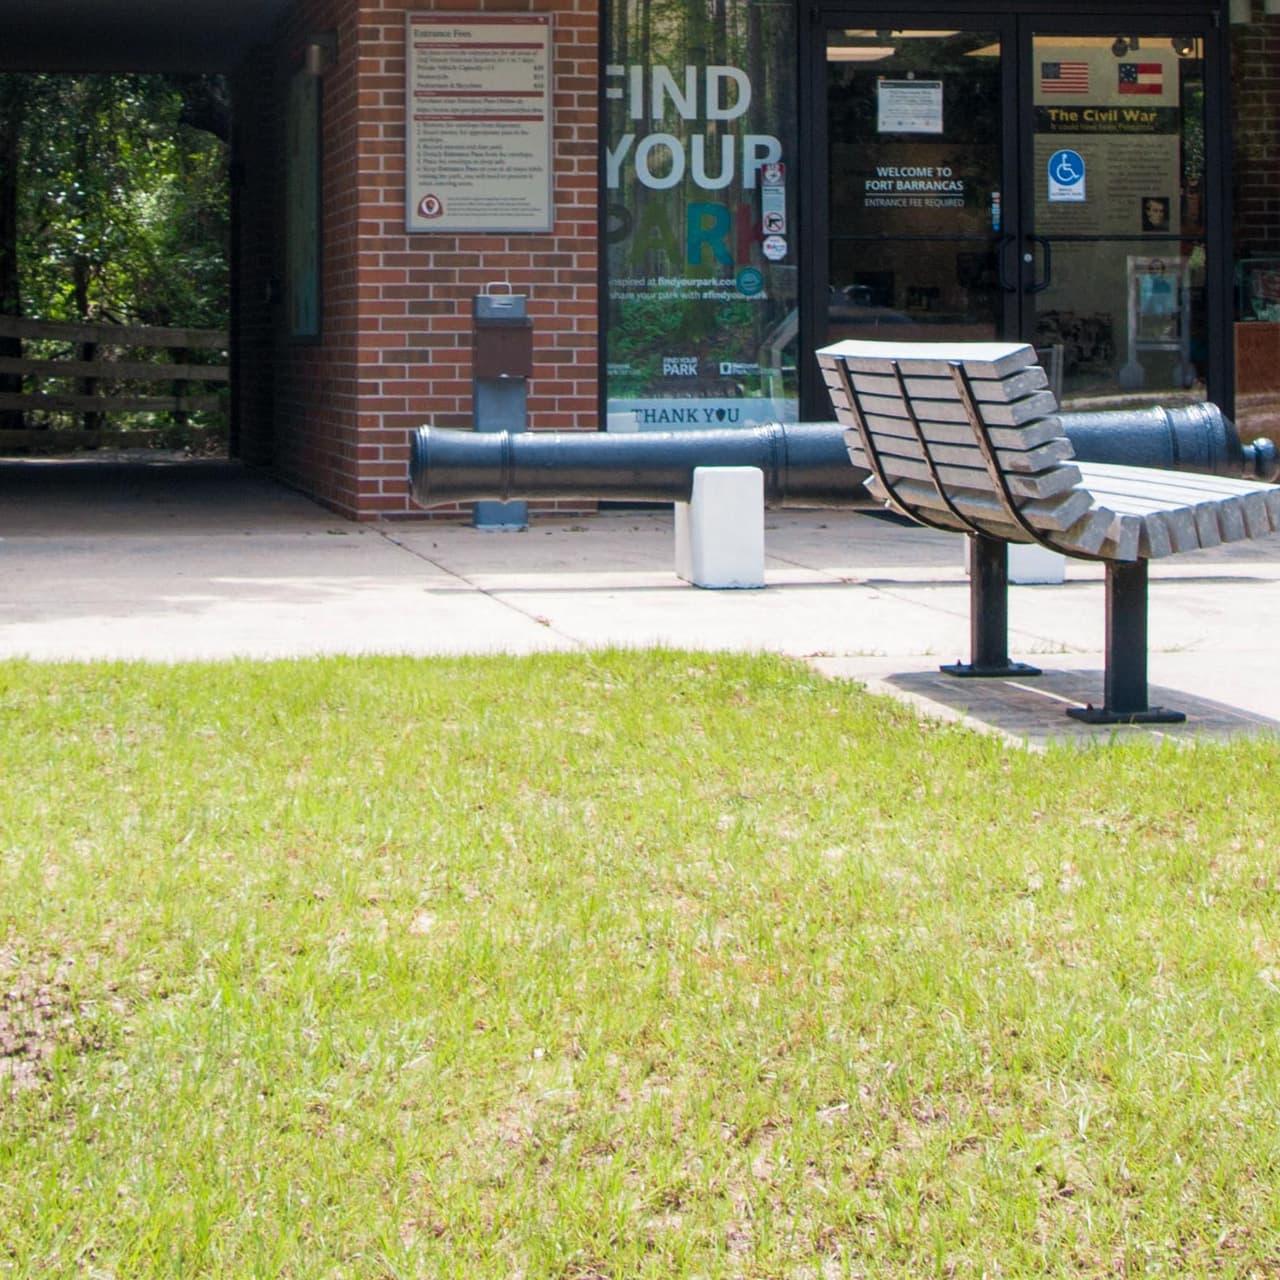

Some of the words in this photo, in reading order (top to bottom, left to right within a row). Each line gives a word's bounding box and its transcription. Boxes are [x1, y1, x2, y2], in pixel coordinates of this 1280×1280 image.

[414, 29, 451, 38] Entrance
[453, 29, 472, 38] Fees
[606, 65, 752, 120] FIND
[1048, 109, 1078, 121] The
[1083, 109, 1118, 121] Civil
[1124, 109, 1157, 122] War
[606, 133, 782, 190] YOUR
[877, 167, 933, 177] WELCOME
[936, 167, 952, 177] TO
[865, 181, 893, 190] FORT
[896, 181, 964, 191] BARRANCAS
[865, 198, 909, 207] ENTRANCE
[910, 198, 925, 207] FEE
[926, 198, 965, 208] REQUIRED
[647, 277, 656, 287] at
[636, 293, 657, 302] your
[658, 291, 680, 302] park
[681, 291, 700, 300] with
[663, 364, 698, 376] PARK
[632, 408, 699, 423] THANK
